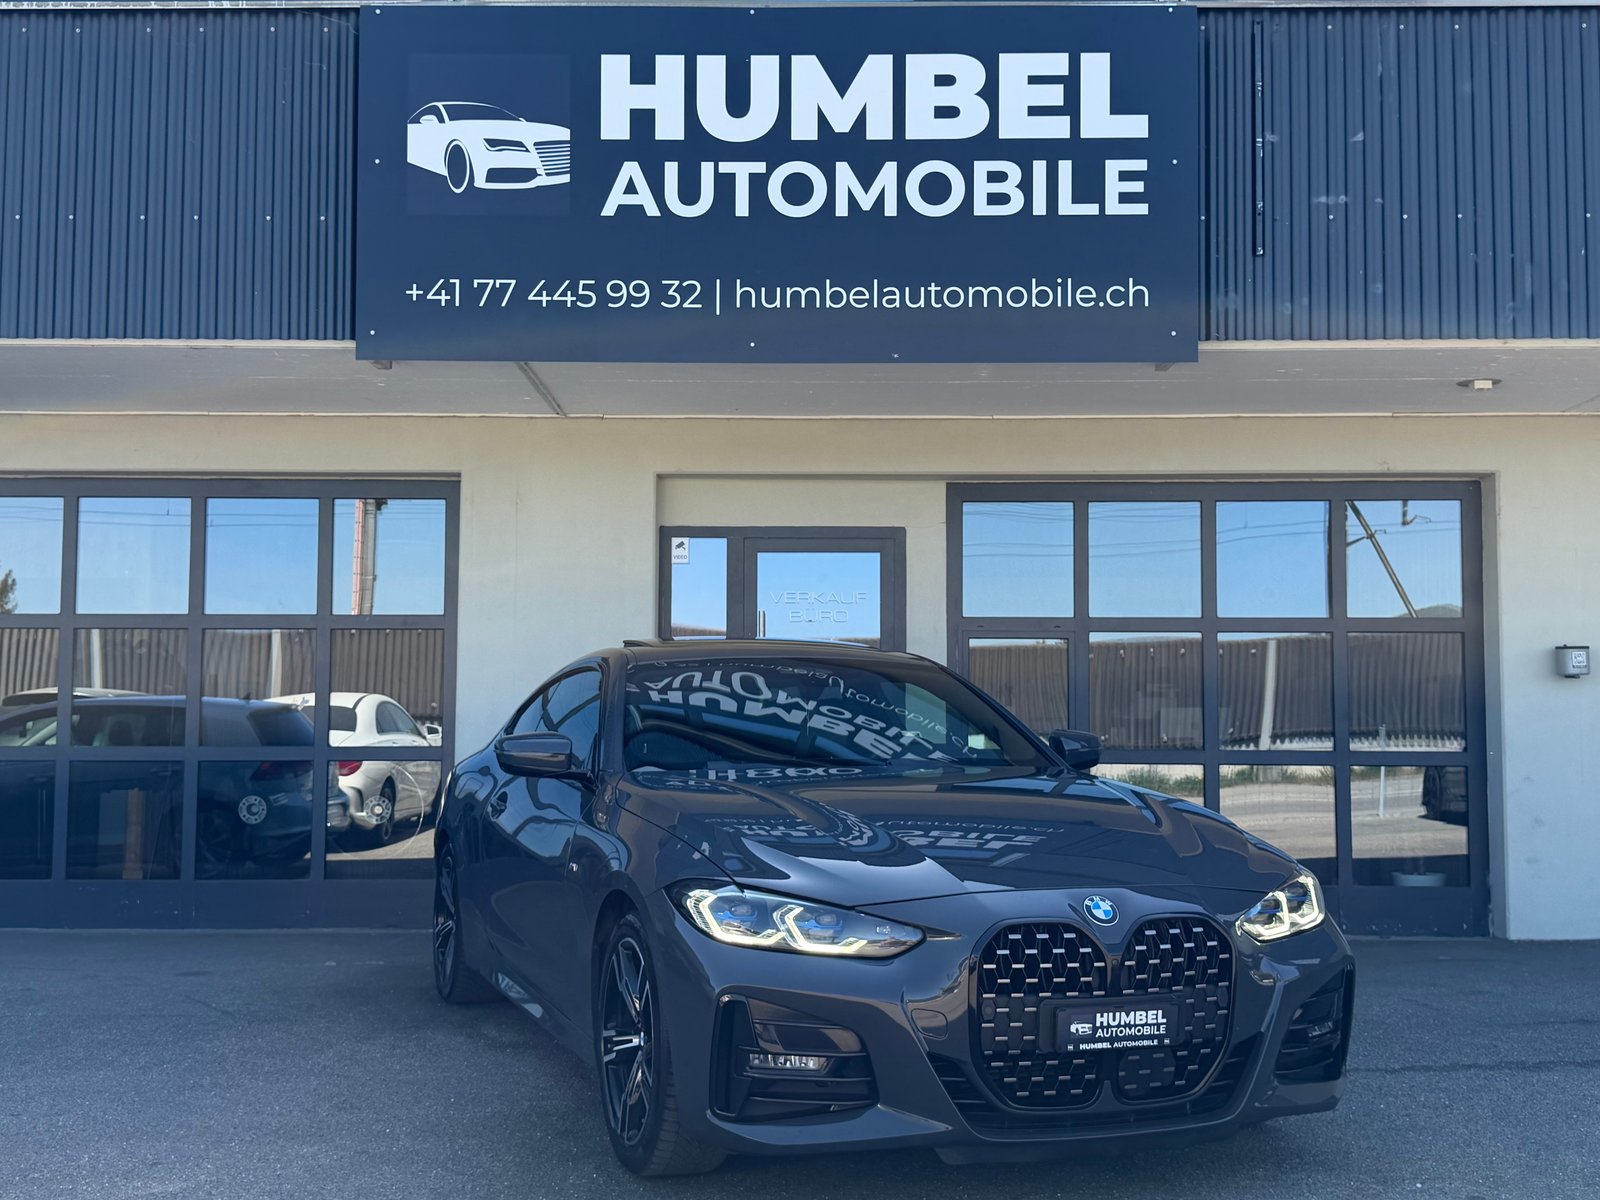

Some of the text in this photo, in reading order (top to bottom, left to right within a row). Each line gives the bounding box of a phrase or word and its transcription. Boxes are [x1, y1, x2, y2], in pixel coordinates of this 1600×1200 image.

[600, 52, 1149, 143] HUMBEL
[600, 159, 1149, 218] AUTOMOBILE
[405, 278, 460, 308] +41
[473, 278, 517, 308] 77
[527, 279, 596, 308] 445
[606, 279, 651, 308] 99
[660, 279, 703, 309] 32
[736, 277, 1149, 309] humbelautomobile.ch
[769, 591, 868, 605] VERKAUF
[788, 607, 849, 623] BÜRO
[1095, 1009, 1167, 1027] HUMBEL
[1095, 1024, 1167, 1038] AUTOMOBILE
[1079, 1039, 1158, 1051] HUMBEL AUTOMOBILE
